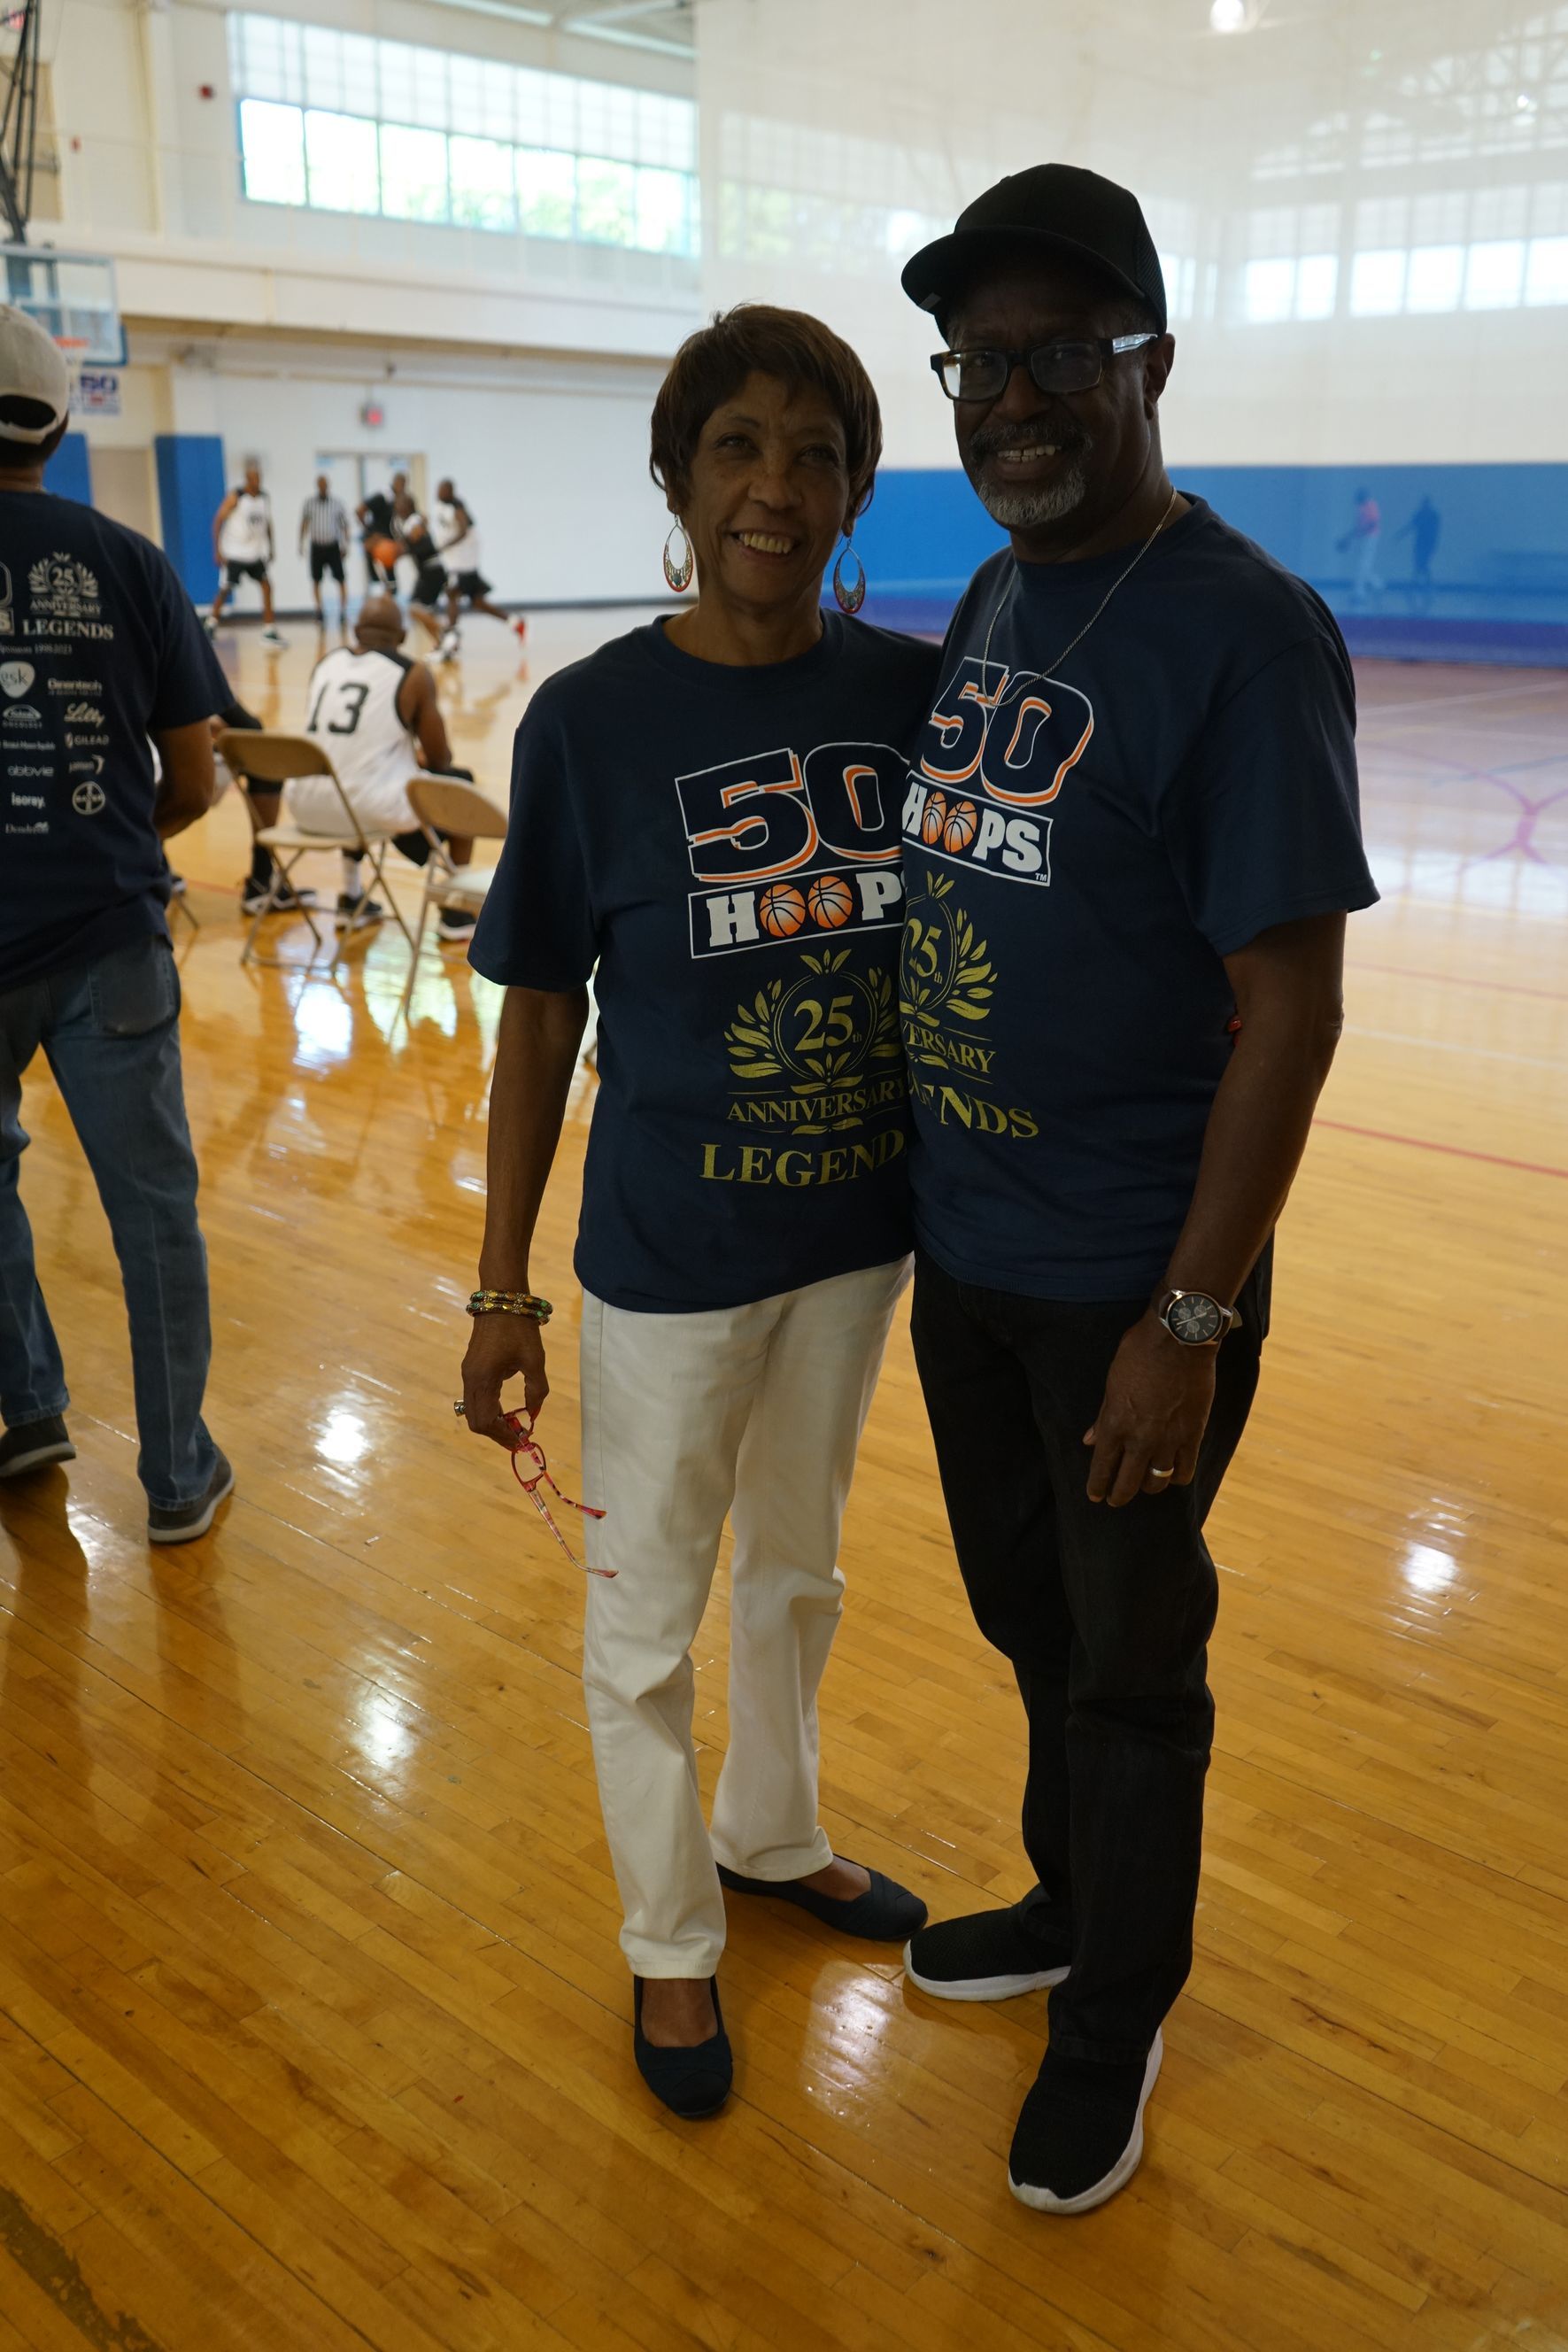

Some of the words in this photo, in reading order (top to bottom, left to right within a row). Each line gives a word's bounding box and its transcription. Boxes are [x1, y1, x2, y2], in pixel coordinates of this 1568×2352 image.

[22, 618, 114, 640] LEGENDS
[308, 682, 369, 734] 13
[920, 656, 1094, 807] 50
[73, 734, 110, 747] GILEAD
[675, 741, 912, 884] 50
[707, 870, 907, 948] HOOP
[902, 1020, 997, 1075] ERSARY
[699, 1128, 907, 1188] LEGEND
